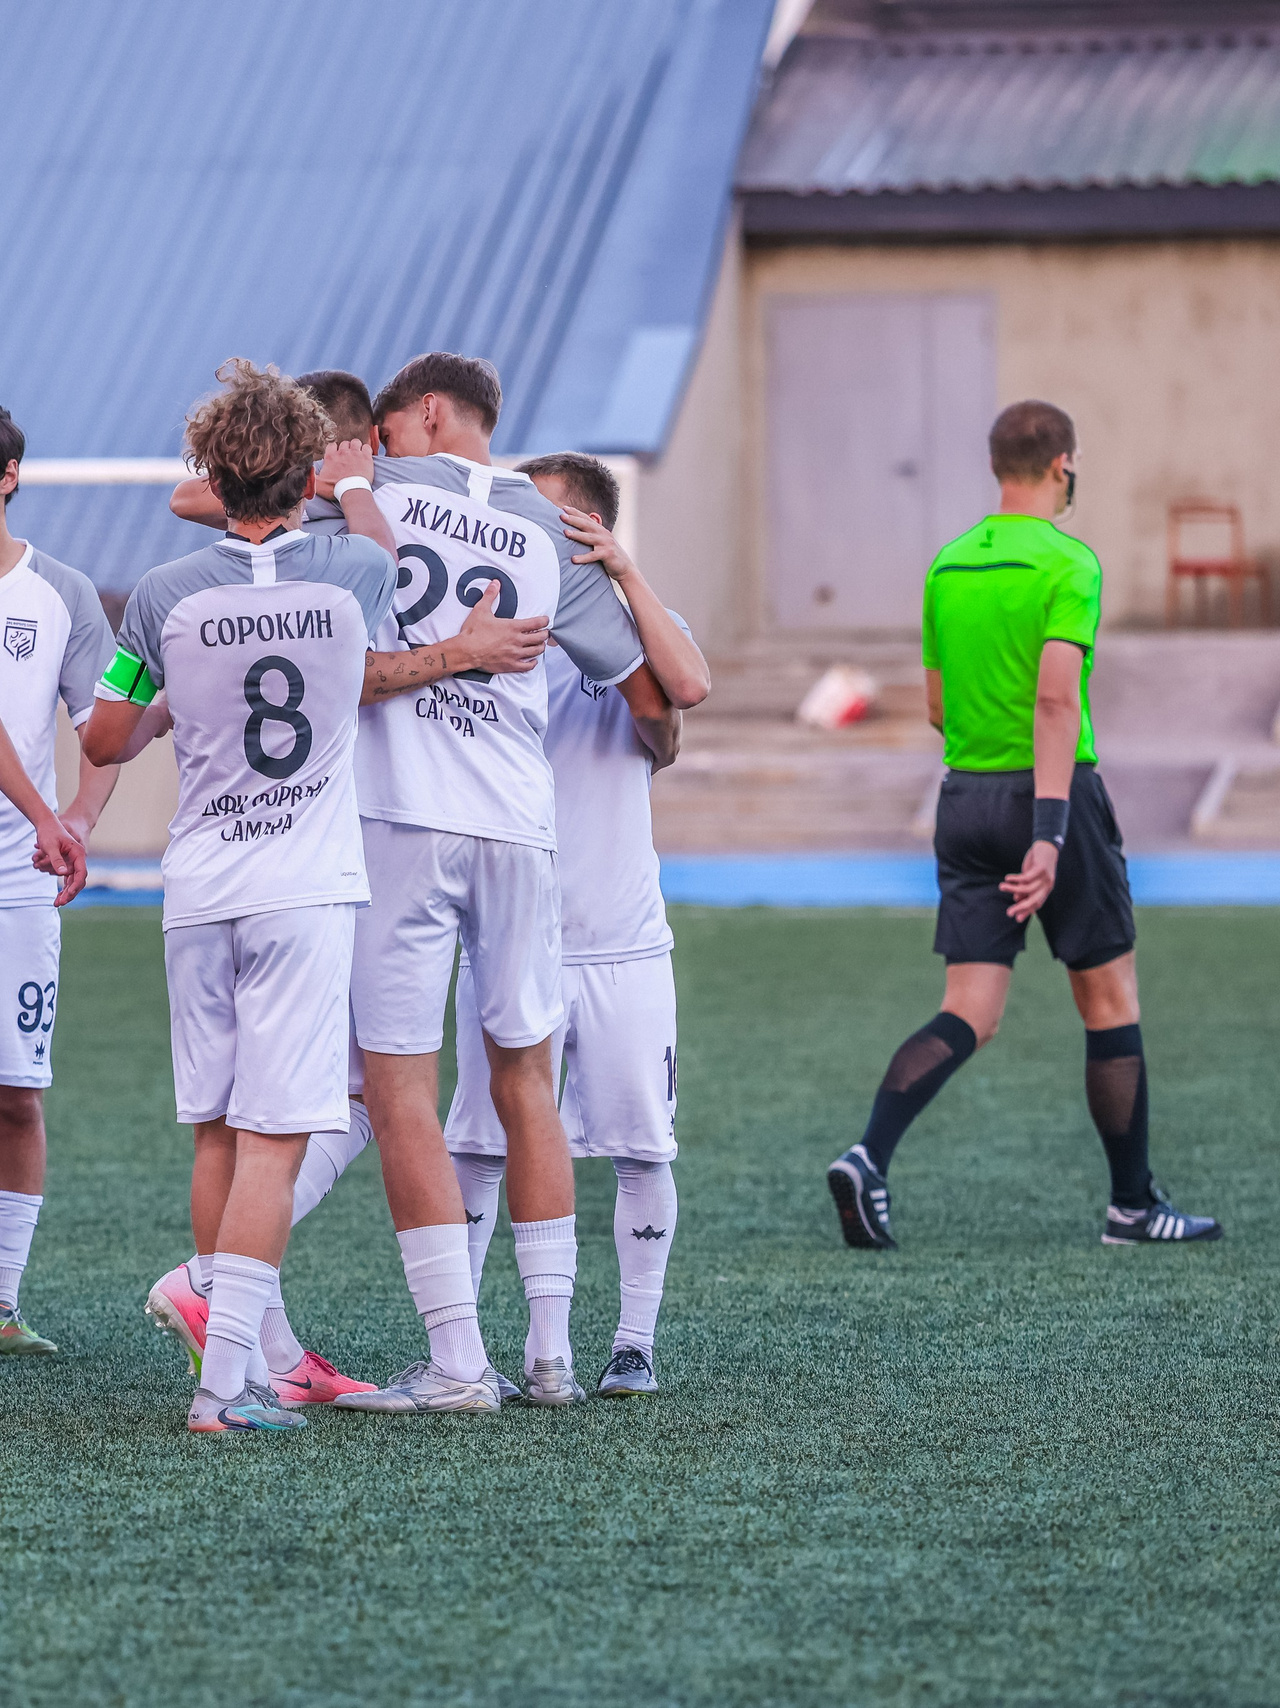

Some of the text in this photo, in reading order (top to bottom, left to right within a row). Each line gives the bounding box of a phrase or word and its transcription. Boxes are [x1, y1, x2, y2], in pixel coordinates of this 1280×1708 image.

[400, 497, 527, 558] ЖИДКОВ
[200, 609, 333, 647] СОРОКИН
[397, 543, 518, 684] 22
[244, 655, 312, 779] 8
[416, 698, 475, 737] САРА
[17, 981, 56, 1033] 93
[663, 1046, 677, 1101] 1
